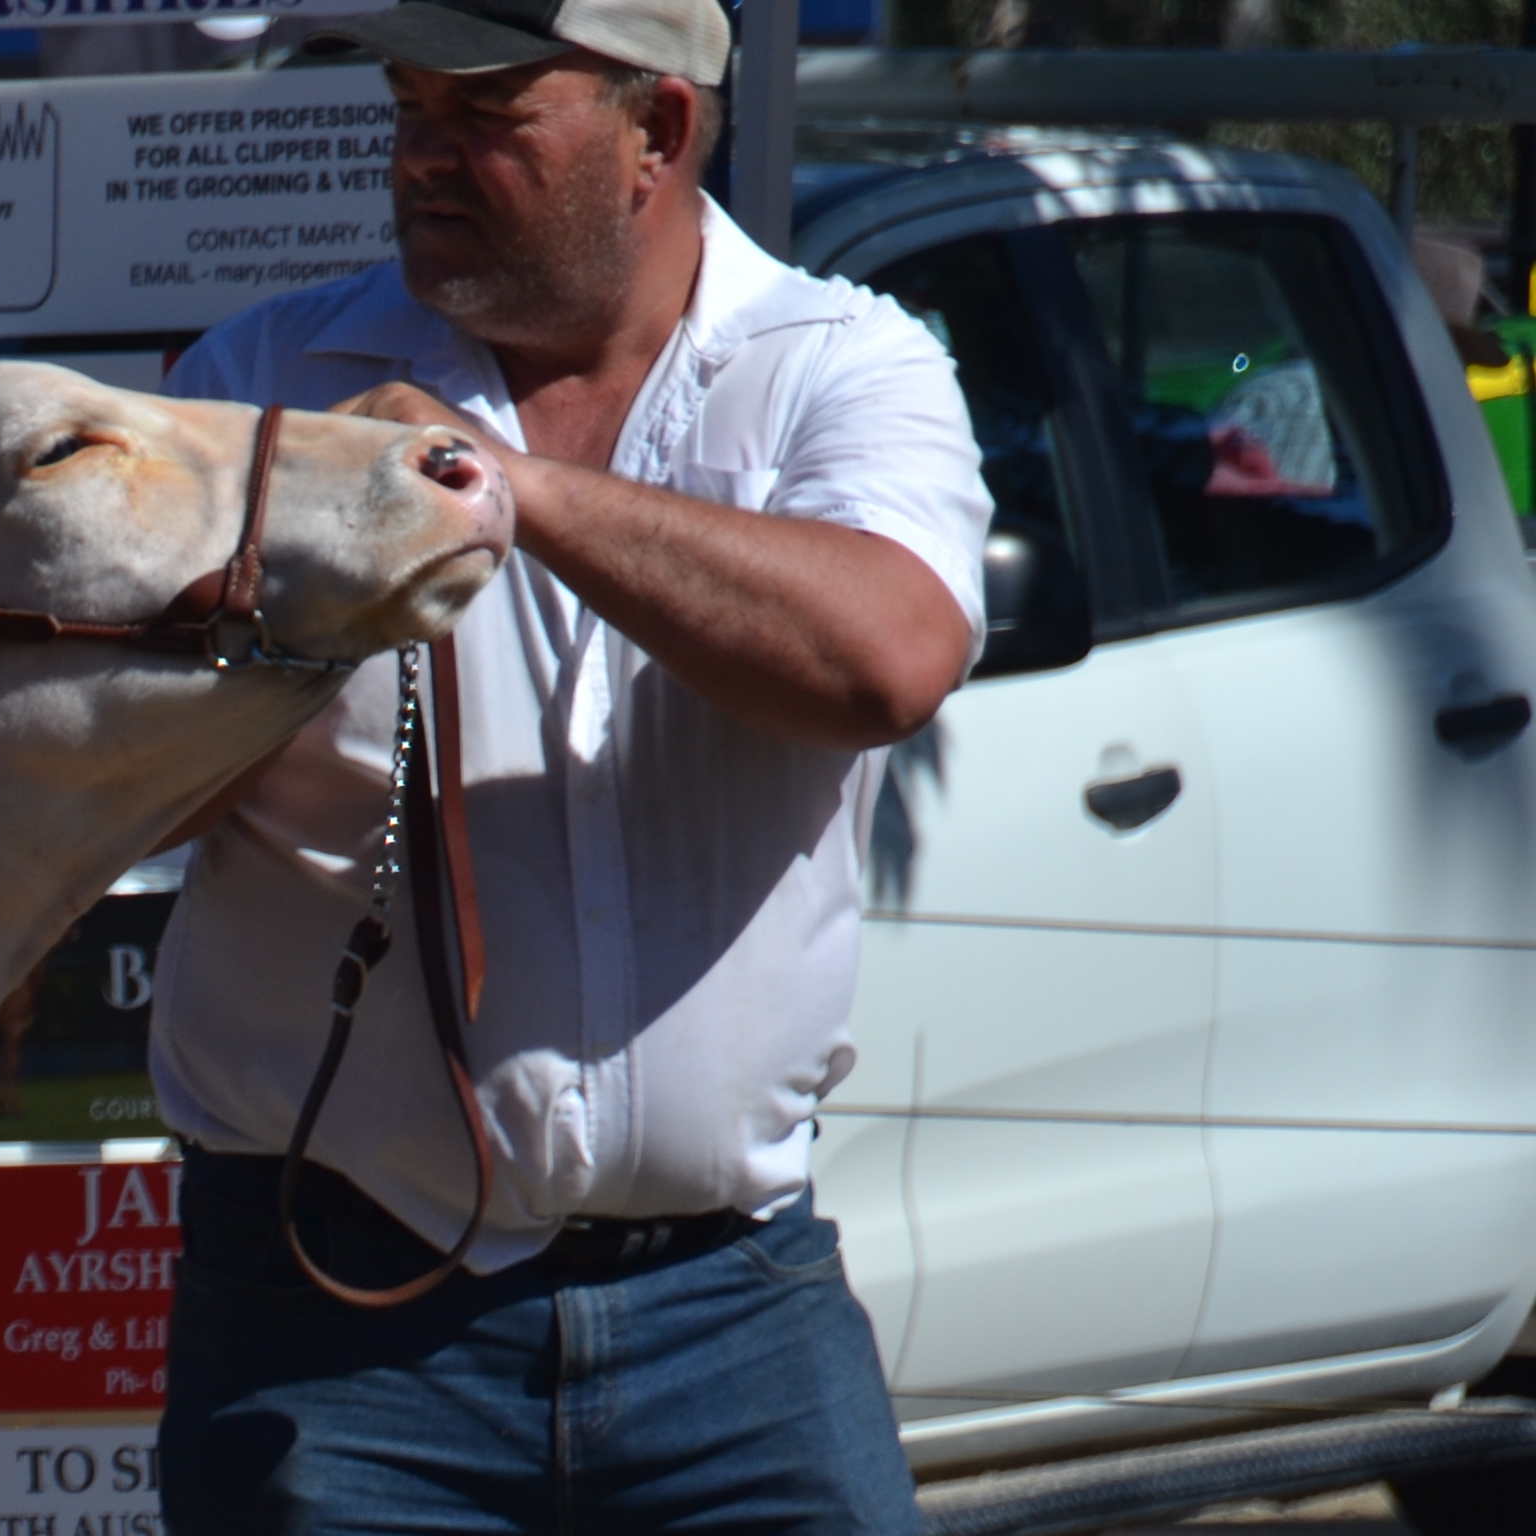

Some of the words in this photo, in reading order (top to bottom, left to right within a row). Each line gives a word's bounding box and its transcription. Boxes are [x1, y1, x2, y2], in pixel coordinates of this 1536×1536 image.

[128, 114, 164, 137] WE
[170, 110, 245, 136] OFFER
[135, 146, 180, 168] FOR
[186, 144, 229, 166] ALL
[235, 138, 331, 165] CLIPPER
[106, 180, 127, 202] IN
[135, 177, 178, 201] THE
[185, 172, 310, 198] GROOMING
[317, 172, 332, 194] &
[186, 225, 292, 252] CONTACT
[298, 222, 361, 246] MARY
[131, 262, 196, 286] EMAIL
[13, 1249, 184, 1293] AYRSH
[4, 1319, 82, 1361] Greg
[89, 1320, 115, 1350] &
[16, 1446, 96, 1494] TO
